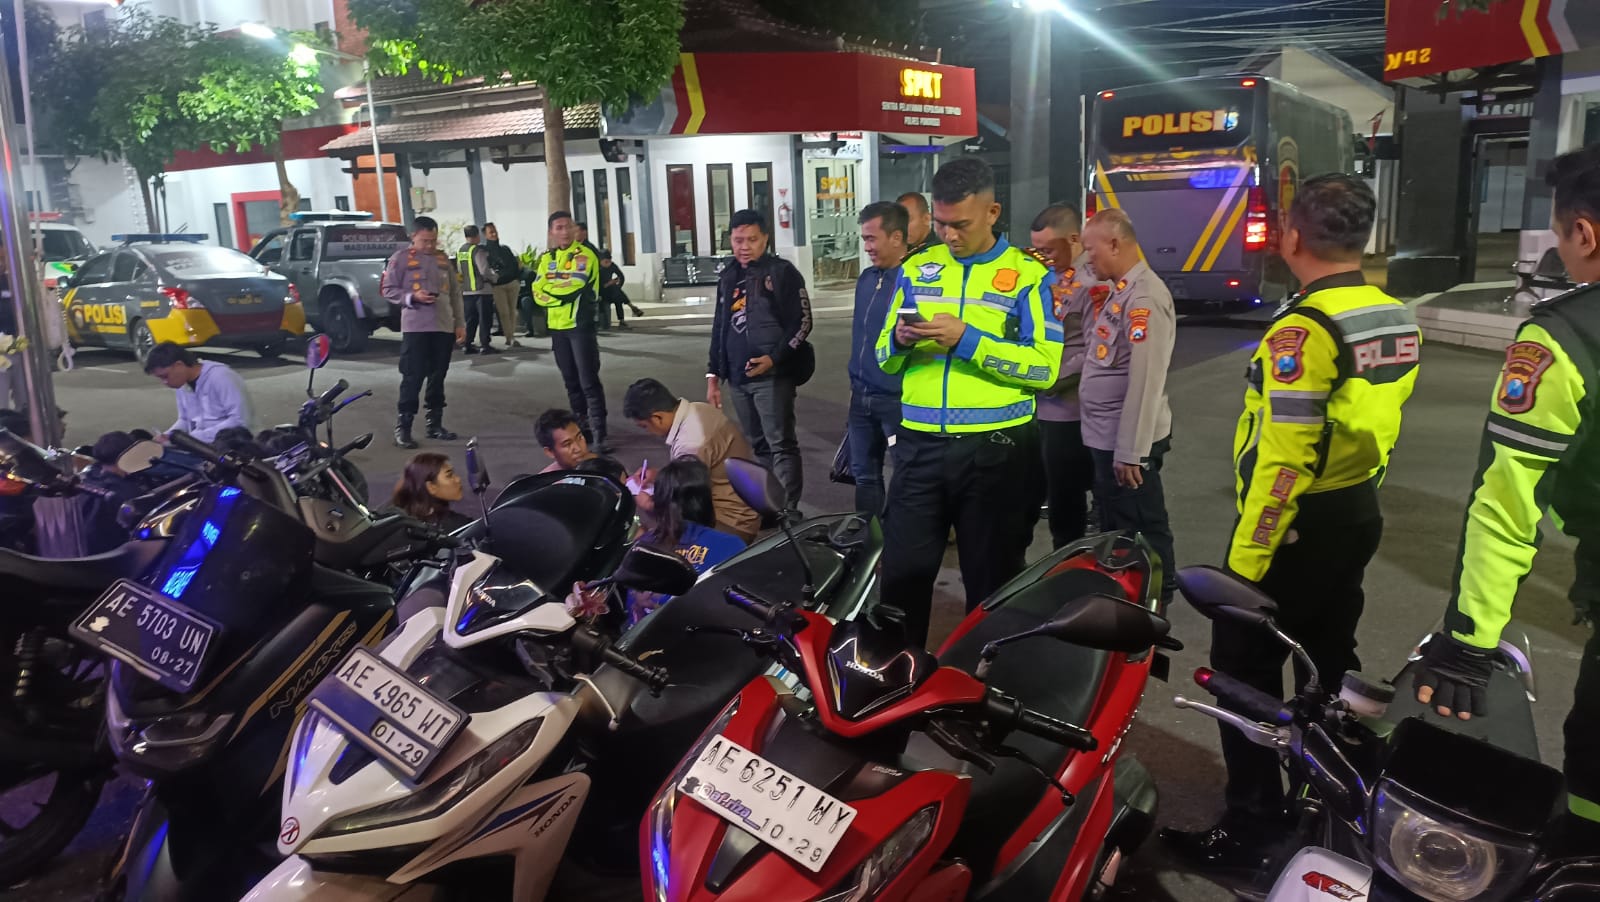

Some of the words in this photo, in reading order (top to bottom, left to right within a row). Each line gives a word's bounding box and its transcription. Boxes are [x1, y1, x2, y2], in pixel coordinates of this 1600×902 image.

[900, 68, 942, 99] SPKT
[1122, 109, 1227, 138] POLISI
[83, 304, 127, 325] POLISI
[105, 592, 139, 618] AE
[136, 604, 178, 640] 5703
[179, 625, 206, 656] UN
[845, 660, 885, 682] HONDA
[340, 659, 375, 689] AE
[372, 679, 422, 719] 4965
[417, 708, 452, 741] WT
[701, 740, 741, 774] AE
[738, 758, 806, 809] 6251
[807, 795, 851, 835] WY
[533, 795, 578, 838] HONDA
